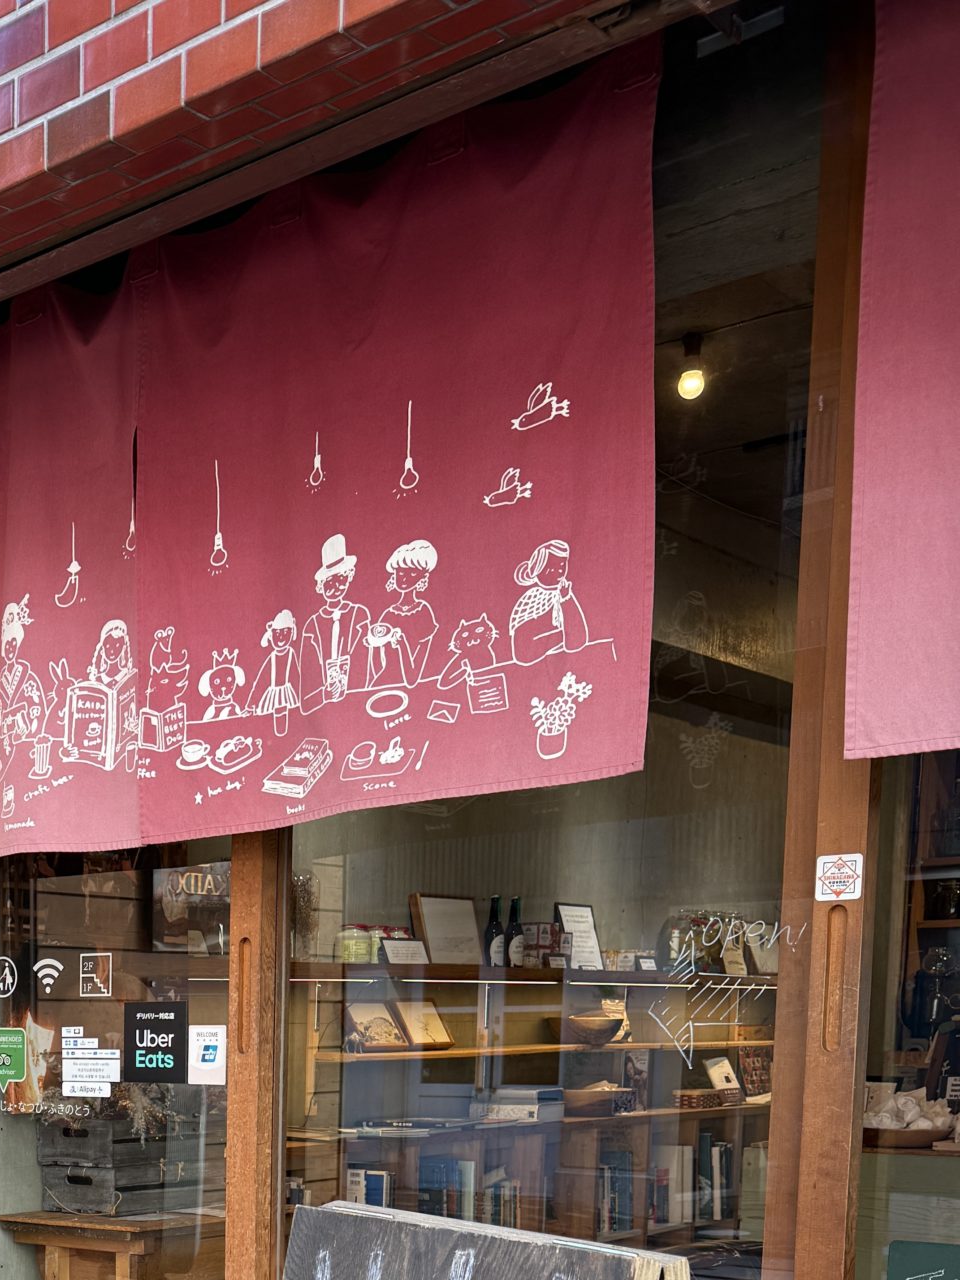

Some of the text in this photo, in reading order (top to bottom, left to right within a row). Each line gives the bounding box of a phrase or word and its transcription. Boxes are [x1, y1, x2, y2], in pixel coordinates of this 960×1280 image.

[164, 710, 184, 723] THE
[362, 781, 397, 792] scone
[83, 961, 95, 971] 2F
[83, 983, 93, 992] 1F
[135, 1029, 175, 1048] Uber
[135, 1049, 175, 1068] Eats
[79, 1085, 97, 1094] Alipay
